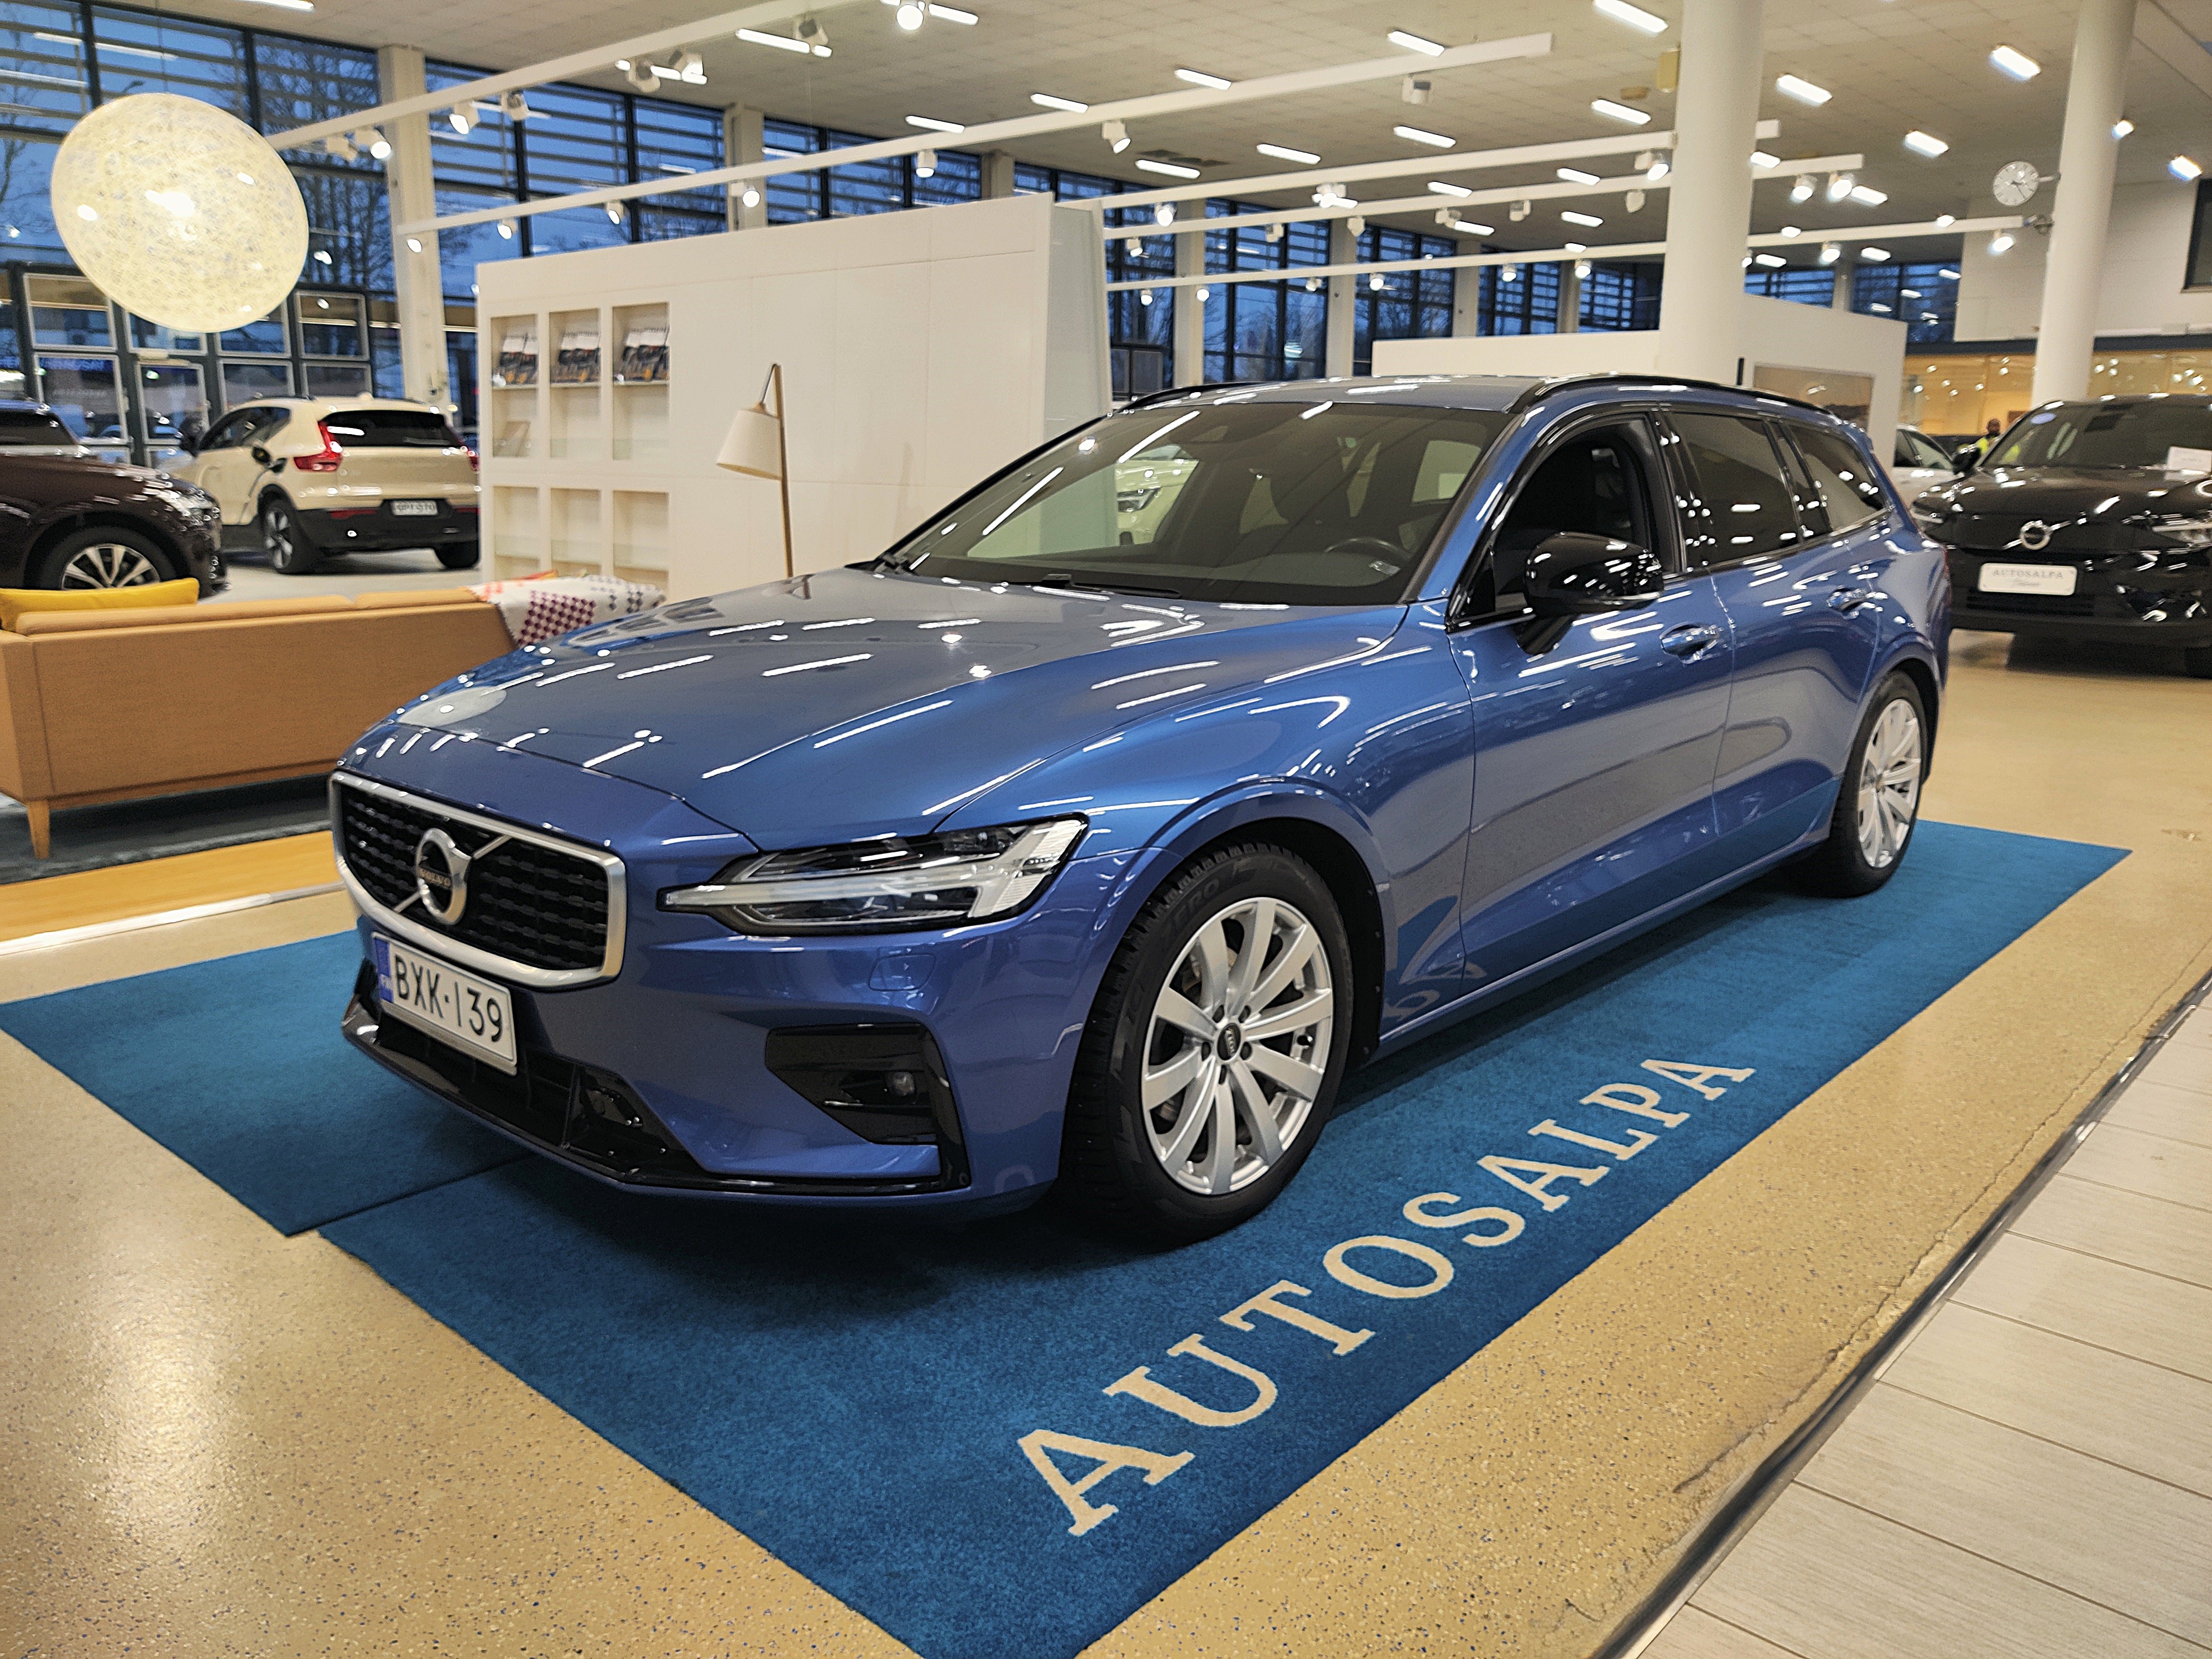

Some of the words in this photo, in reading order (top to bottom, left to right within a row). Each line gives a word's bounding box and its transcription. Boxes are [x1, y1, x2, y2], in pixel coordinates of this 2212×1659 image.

[1992, 569, 2064, 580] AUTOSALPA
[418, 867, 451, 887] VOLVO
[394, 954, 503, 1042] BXK-139
[1018, 1058, 1755, 1536] AUTOSALPA
